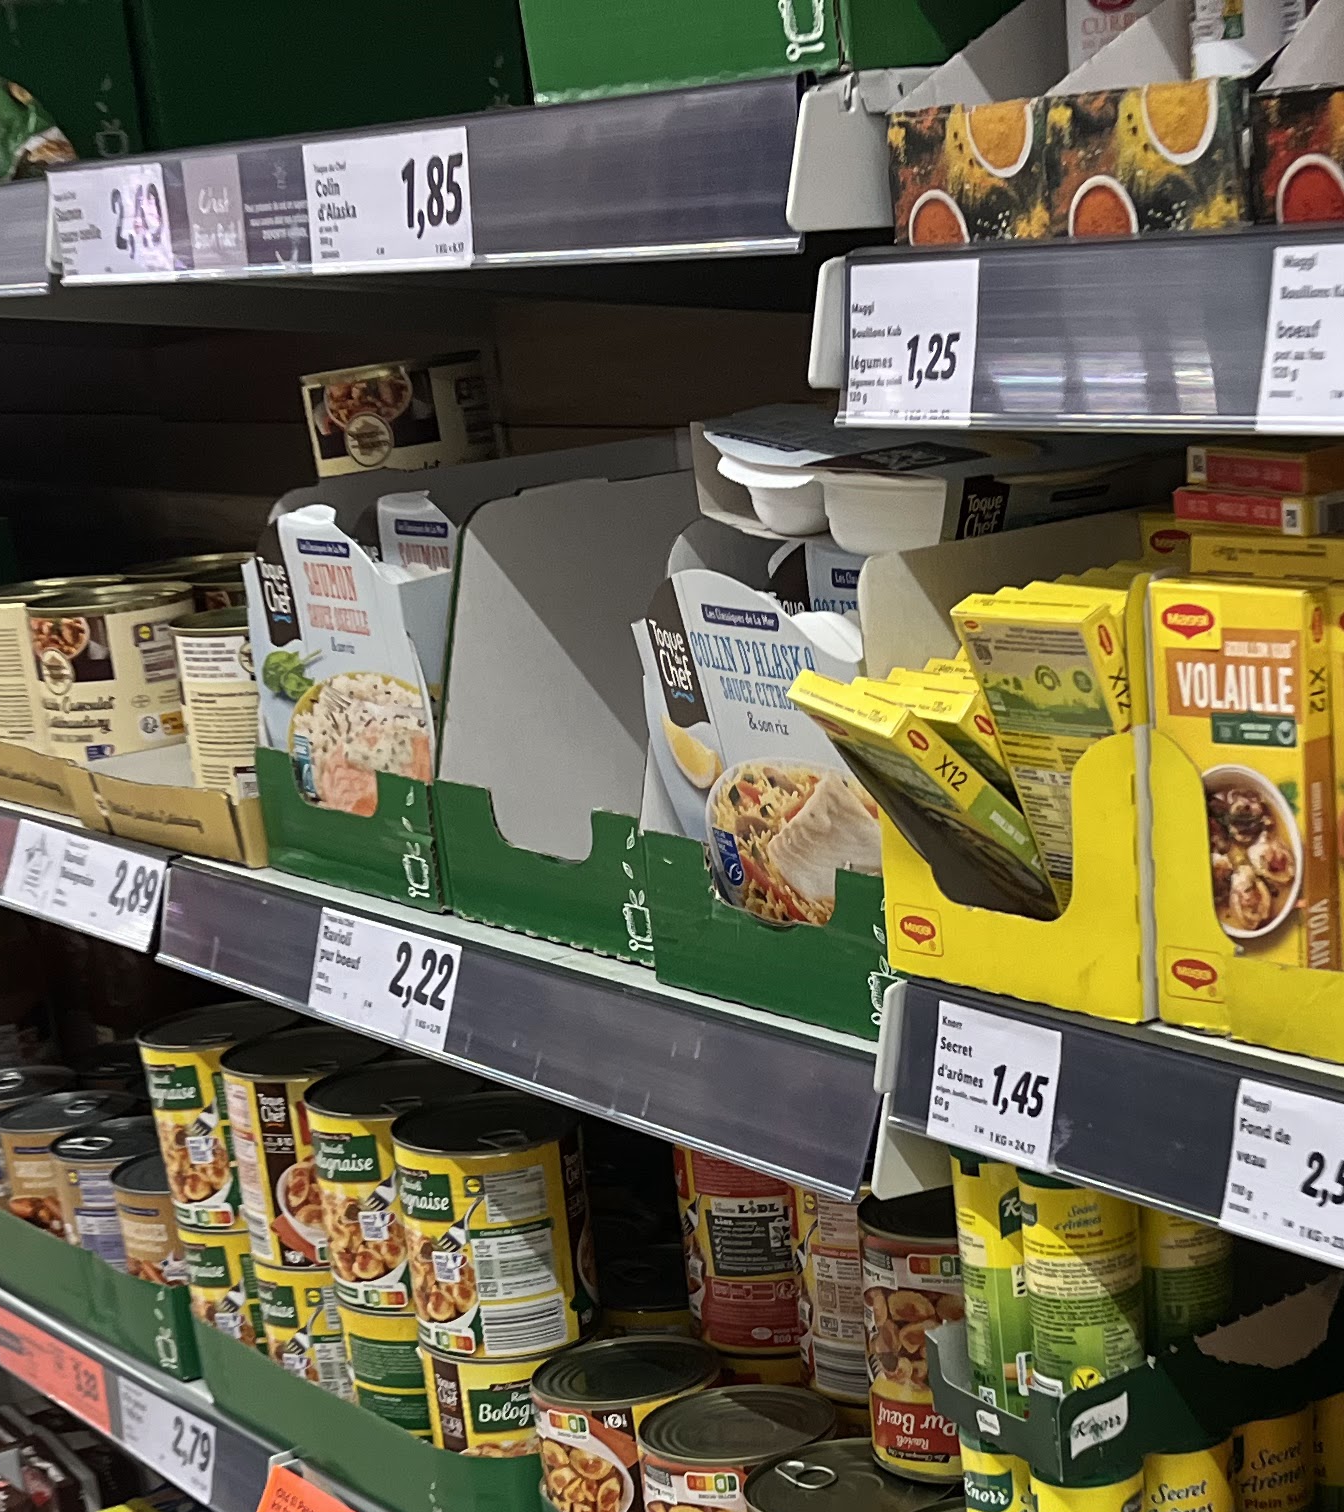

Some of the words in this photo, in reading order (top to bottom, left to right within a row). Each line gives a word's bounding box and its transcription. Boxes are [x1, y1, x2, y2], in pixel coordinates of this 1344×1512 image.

[315, 179, 341, 198] Colin
[401, 152, 463, 240] 1,85
[317, 202, 357, 221] d'Alaska
[852, 302, 875, 315] Maggi
[852, 327, 886, 339] Bouillons
[887, 325, 902, 337] Kub
[851, 355, 893, 374] légumes
[907, 332, 961, 389] 1,25
[967, 494, 1002, 515] Toque
[964, 514, 1001, 539] Chef
[256, 556, 286, 581] Toque
[303, 561, 358, 601] SAUMON
[263, 580, 292, 614] Chef
[307, 603, 335, 631] SAUCE
[763, 614, 775, 627] Mer
[649, 620, 684, 652] Toque
[689, 631, 738, 673] COLIN
[735, 639, 816, 682] D'ALASKA
[659, 650, 692, 691] Chef
[719, 676, 756, 706] SAUCE
[756, 682, 803, 712] CITRO
[1176, 661, 1296, 714] VOLAILLE
[747, 711, 758, 730] &
[757, 718, 773, 734] son
[773, 720, 789, 736] riz
[935, 754, 969, 792] X12
[323, 925, 354, 946] Ravioli
[336, 950, 362, 970] boeuf
[388, 941, 454, 1011] 2,22
[942, 1015, 963, 1030] Knorr
[940, 1036, 973, 1058] Secret
[937, 1063, 984, 1089] d'arômes
[934, 1095, 944, 1106] 60
[992, 1064, 1049, 1118] 1,45
[261, 1105, 287, 1124] Chef
[995, 1133, 1007, 1146] KG
[1240, 1116, 1272, 1140] Fond
[737, 1202, 779, 1214] LIDL
[878, 1402, 916, 1431] Bœuf
[1072, 1414, 1123, 1439] Knorr
[171, 1415, 212, 1473] 2,79
[896, 1434, 929, 1449] Ravioli
[963, 1477, 1010, 1506] Knorr
[1151, 1479, 1209, 1504] Secret
